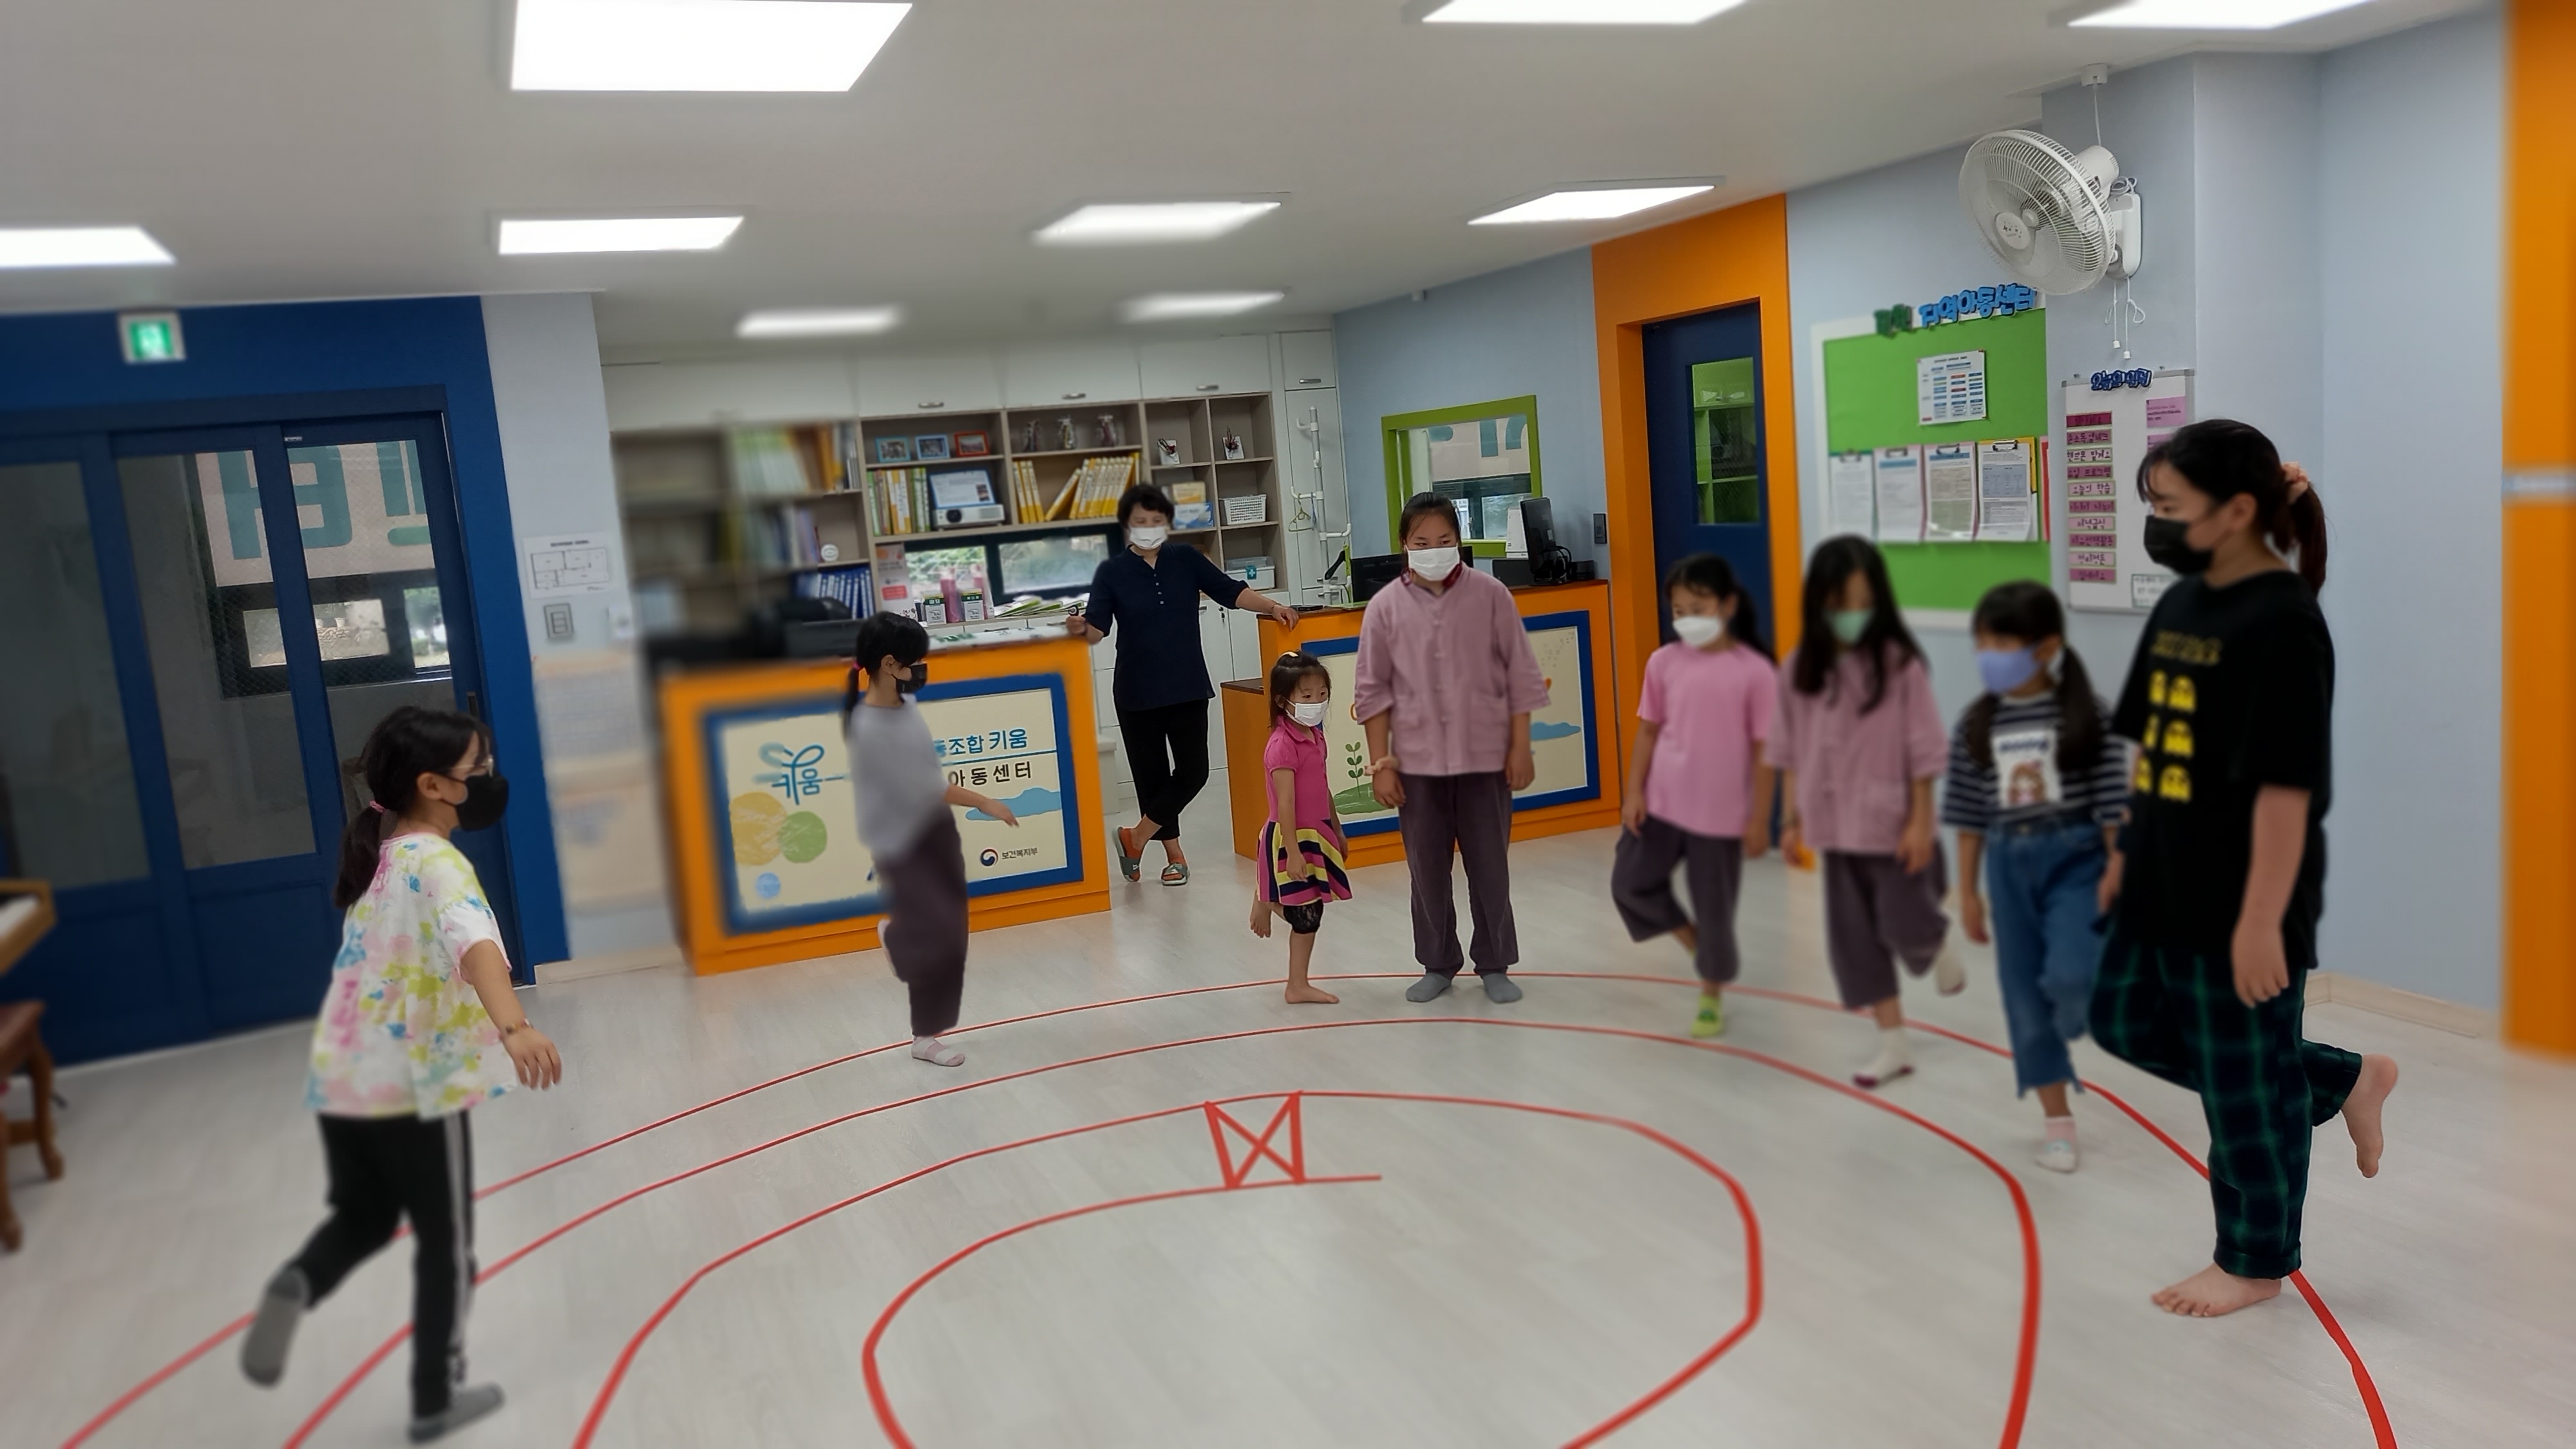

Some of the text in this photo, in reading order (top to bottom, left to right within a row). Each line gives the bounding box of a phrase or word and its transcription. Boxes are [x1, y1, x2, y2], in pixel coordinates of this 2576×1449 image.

[1918, 283, 2037, 329] 지역아동센터
[989, 728, 1028, 750] 키움
[1001, 848, 1038, 860] 보건복지부
